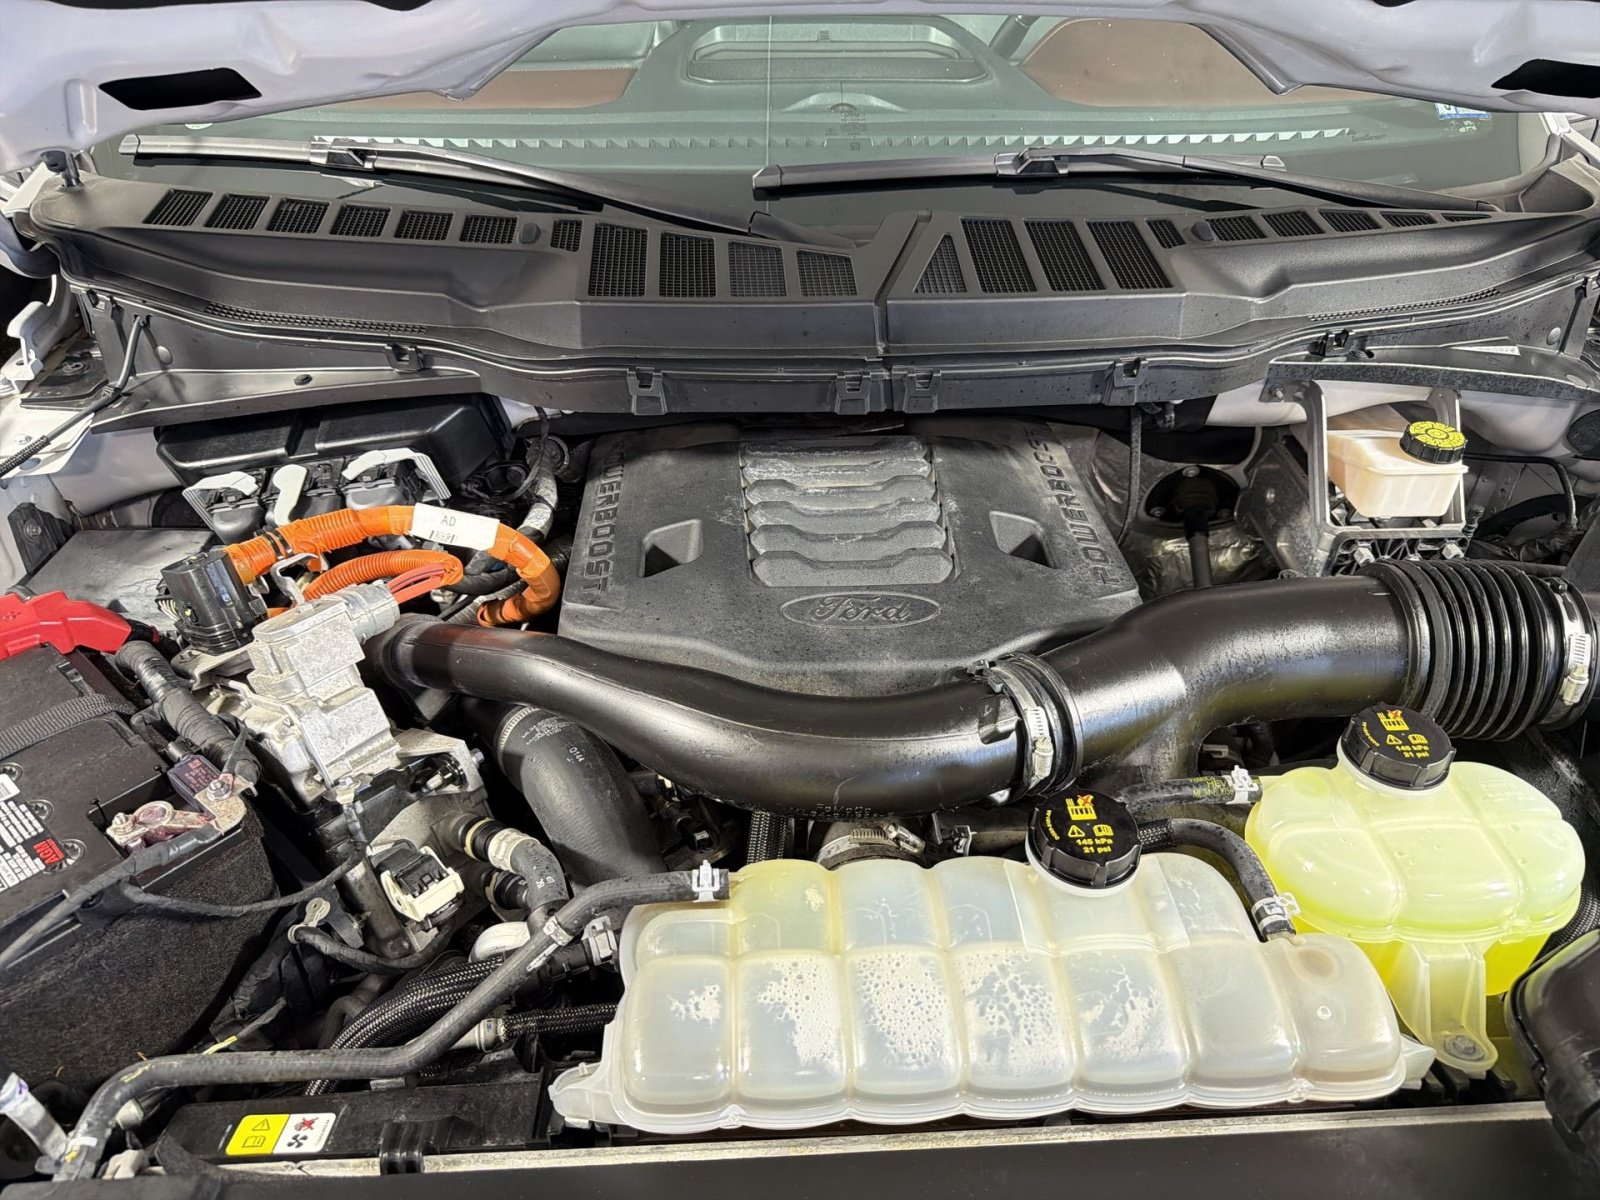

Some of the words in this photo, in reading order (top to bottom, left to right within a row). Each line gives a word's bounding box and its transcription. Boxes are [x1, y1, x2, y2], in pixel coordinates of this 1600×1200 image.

[441, 515, 456, 527] AD
[809, 596, 912, 622] Ford
[33, 840, 59, 865] AGM
[1097, 846, 1112, 854] psi
